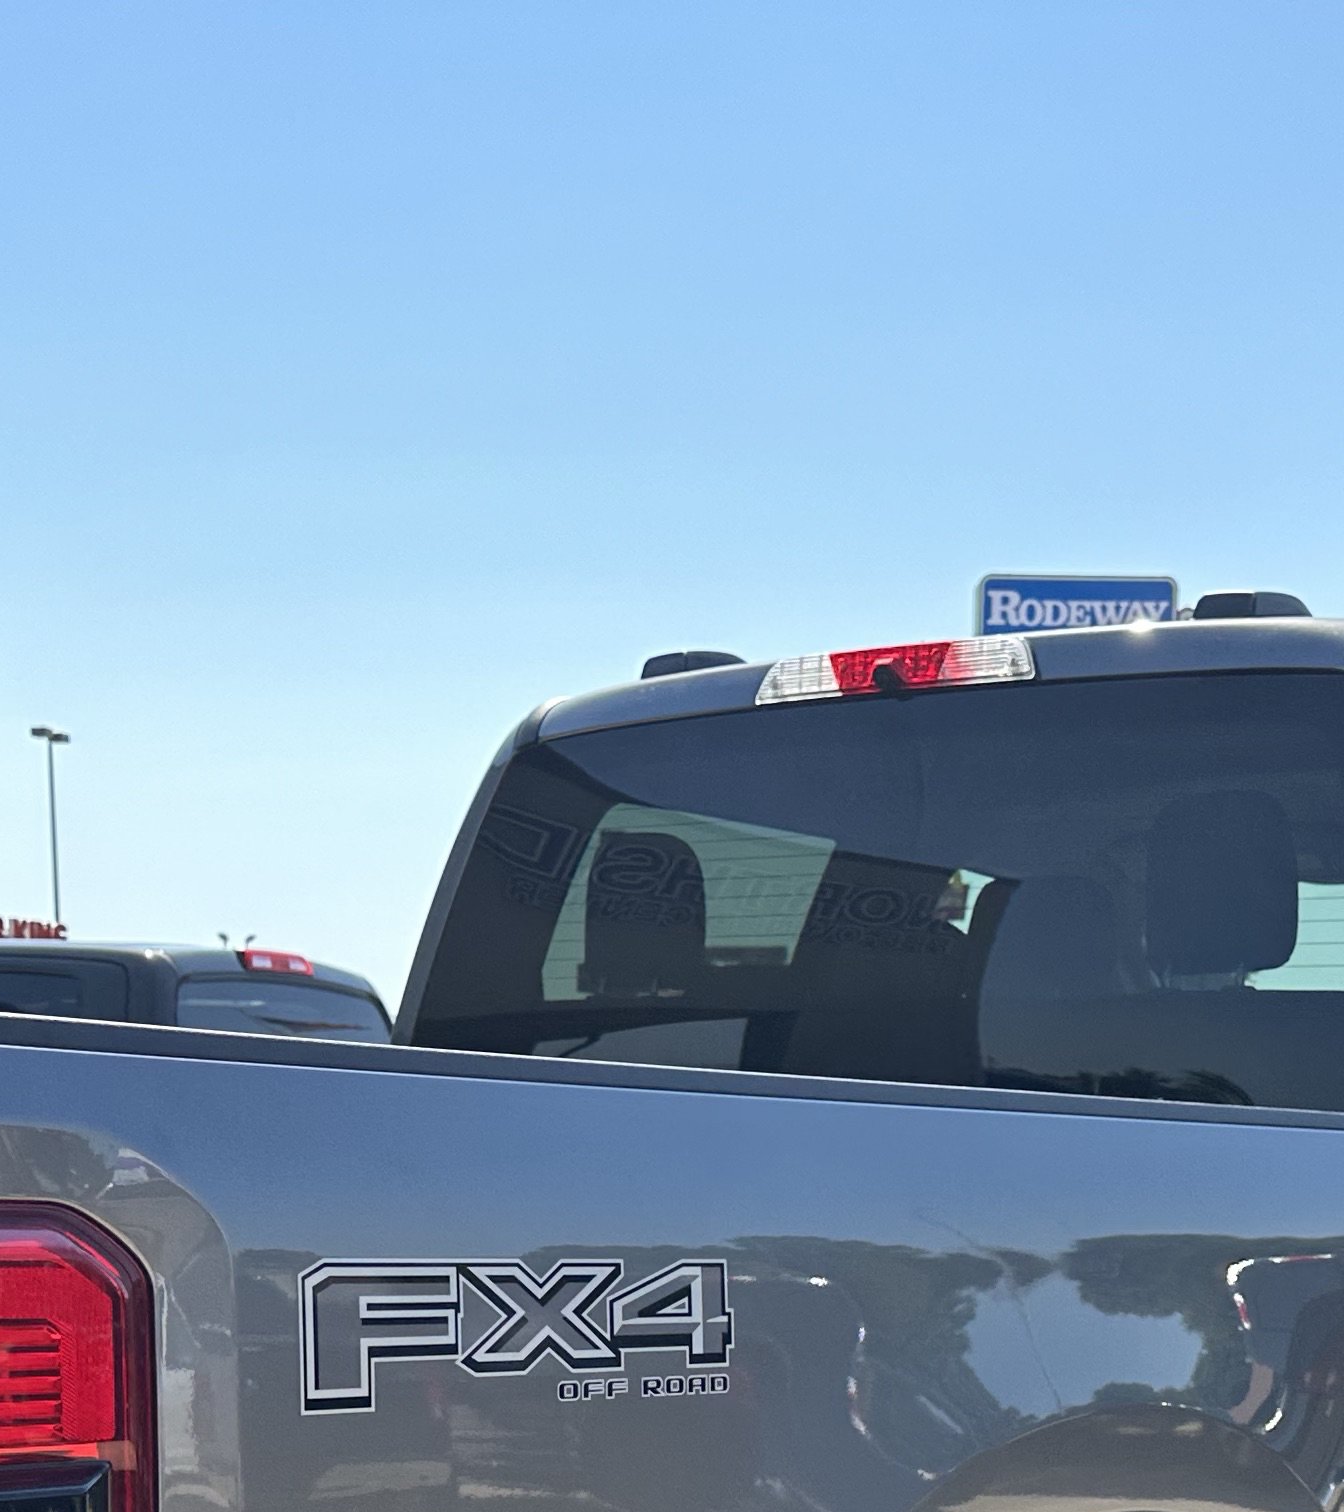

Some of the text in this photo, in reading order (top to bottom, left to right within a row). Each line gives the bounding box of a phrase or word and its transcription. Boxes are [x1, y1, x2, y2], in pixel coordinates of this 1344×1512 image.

[298, 1258, 734, 1416] FX4
[557, 1373, 730, 1401] OFF ROAD
